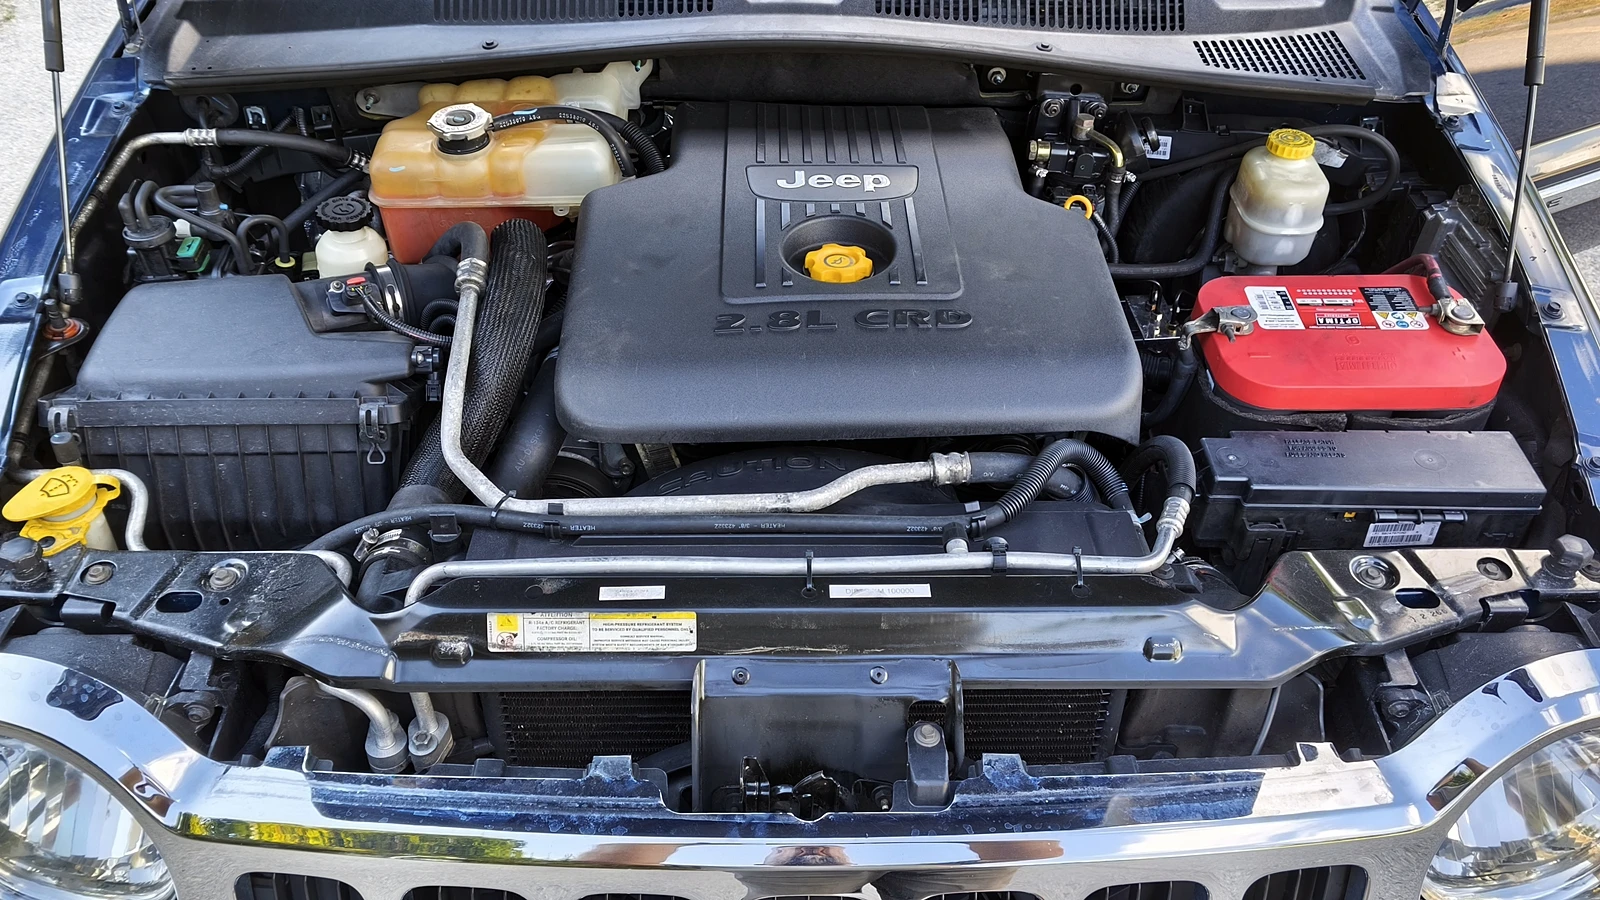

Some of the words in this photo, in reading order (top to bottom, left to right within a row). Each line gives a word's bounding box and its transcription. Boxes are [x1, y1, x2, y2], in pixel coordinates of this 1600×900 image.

[776, 170, 891, 192] Jeep
[713, 309, 838, 333] 2.8L
[854, 308, 973, 329] CRD
[656, 456, 846, 496] CAUTION
